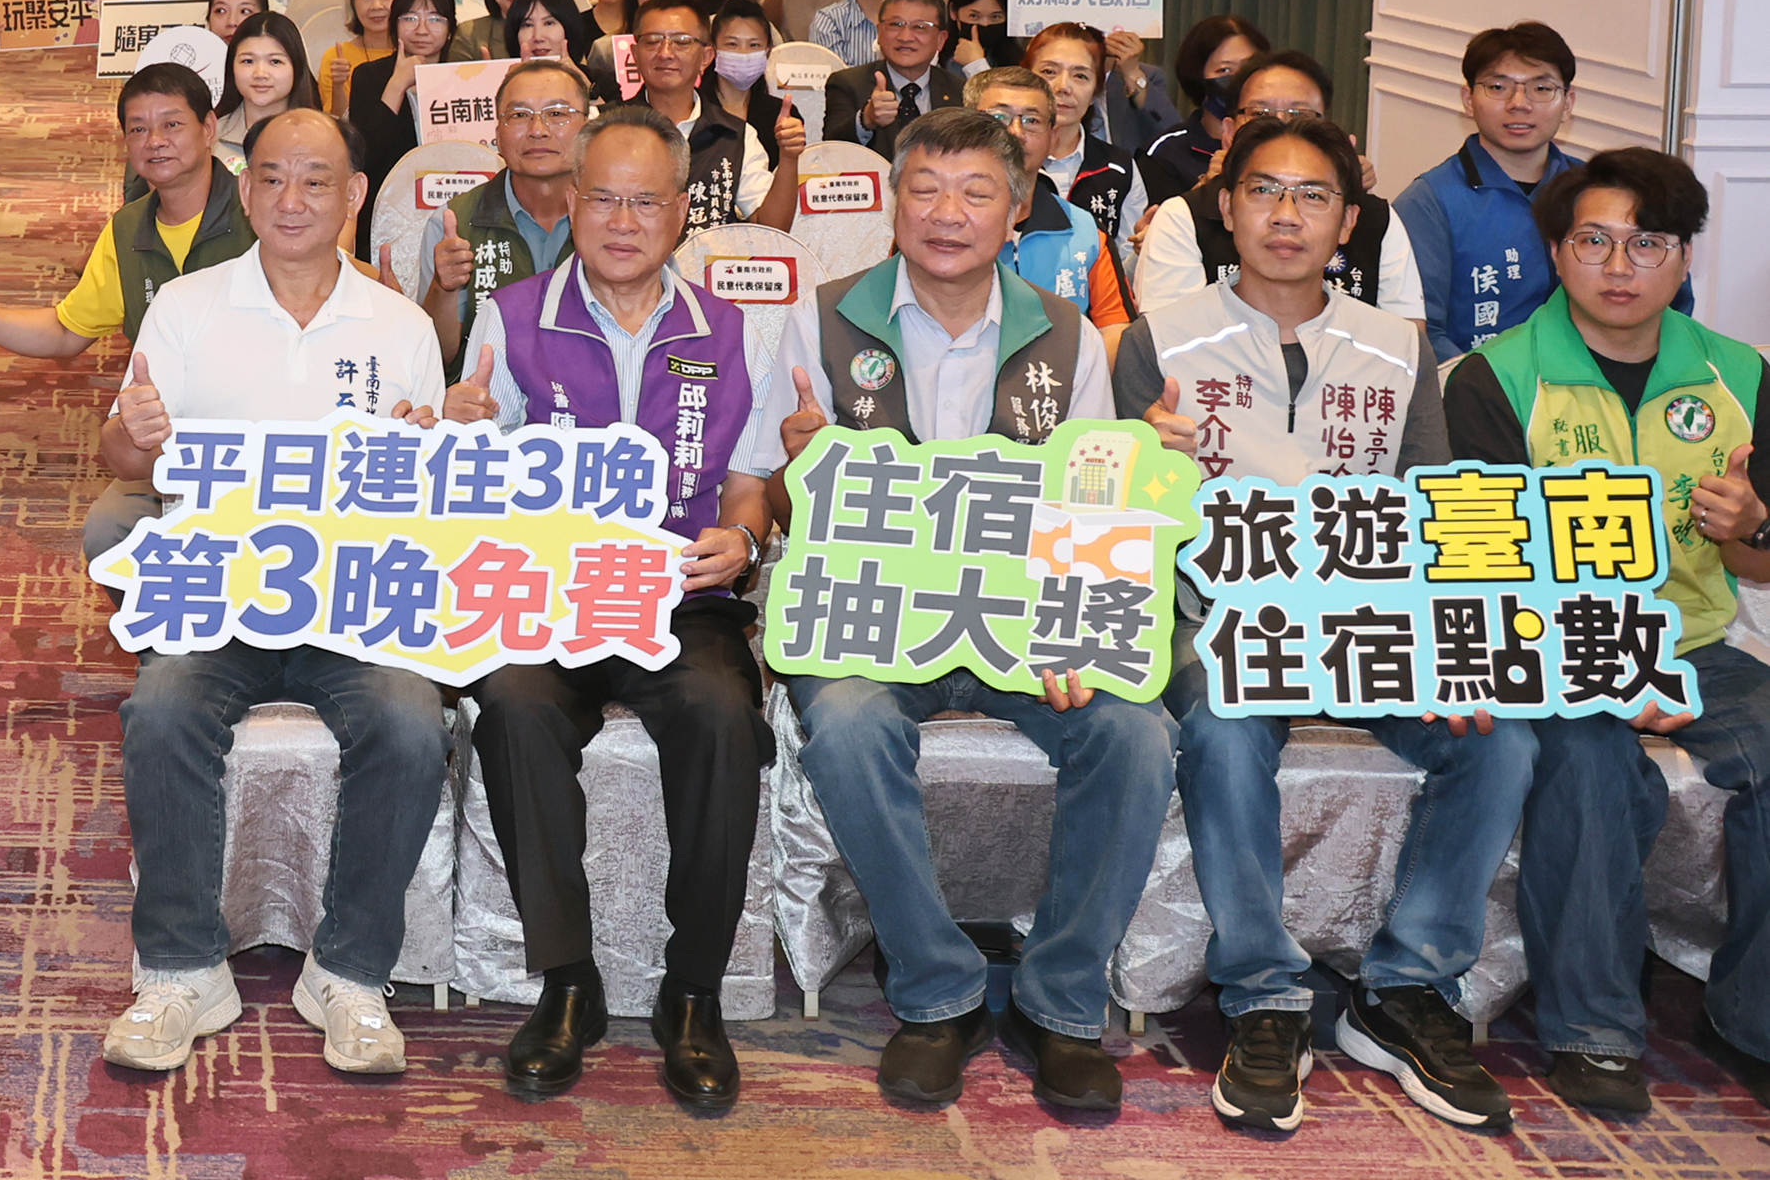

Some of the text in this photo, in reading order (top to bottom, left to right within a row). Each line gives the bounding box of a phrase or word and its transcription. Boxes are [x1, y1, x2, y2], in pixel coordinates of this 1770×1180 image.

[114, 23, 207, 53] 隨寓
[429, 96, 497, 126] 台南桂
[812, 193, 869, 203] 民意代表保留席
[498, 241, 513, 275] 特助
[1073, 251, 1089, 298] 市議員
[1504, 247, 1522, 280] 助理
[717, 281, 783, 292] 民意代表保留席
[1055, 269, 1077, 298] 盧
[681, 363, 713, 375] DPP
[1235, 374, 1253, 409] 特助
[673, 383, 707, 470] 邱莉莉
[1196, 378, 1233, 486] 李介文
[1363, 386, 1396, 474] 陳亭
[1573, 423, 1608, 454] 服
[165, 431, 657, 520] 平日連住3晚
[670, 472, 697, 519] 服務隊
[803, 441, 1044, 557] 住宿
[1194, 468, 1658, 584] 旅遊臺南
[124, 524, 673, 658] 第3晚免費
[781, 555, 1156, 687] 抽大獎
[1209, 592, 1687, 707] 住宿點數
